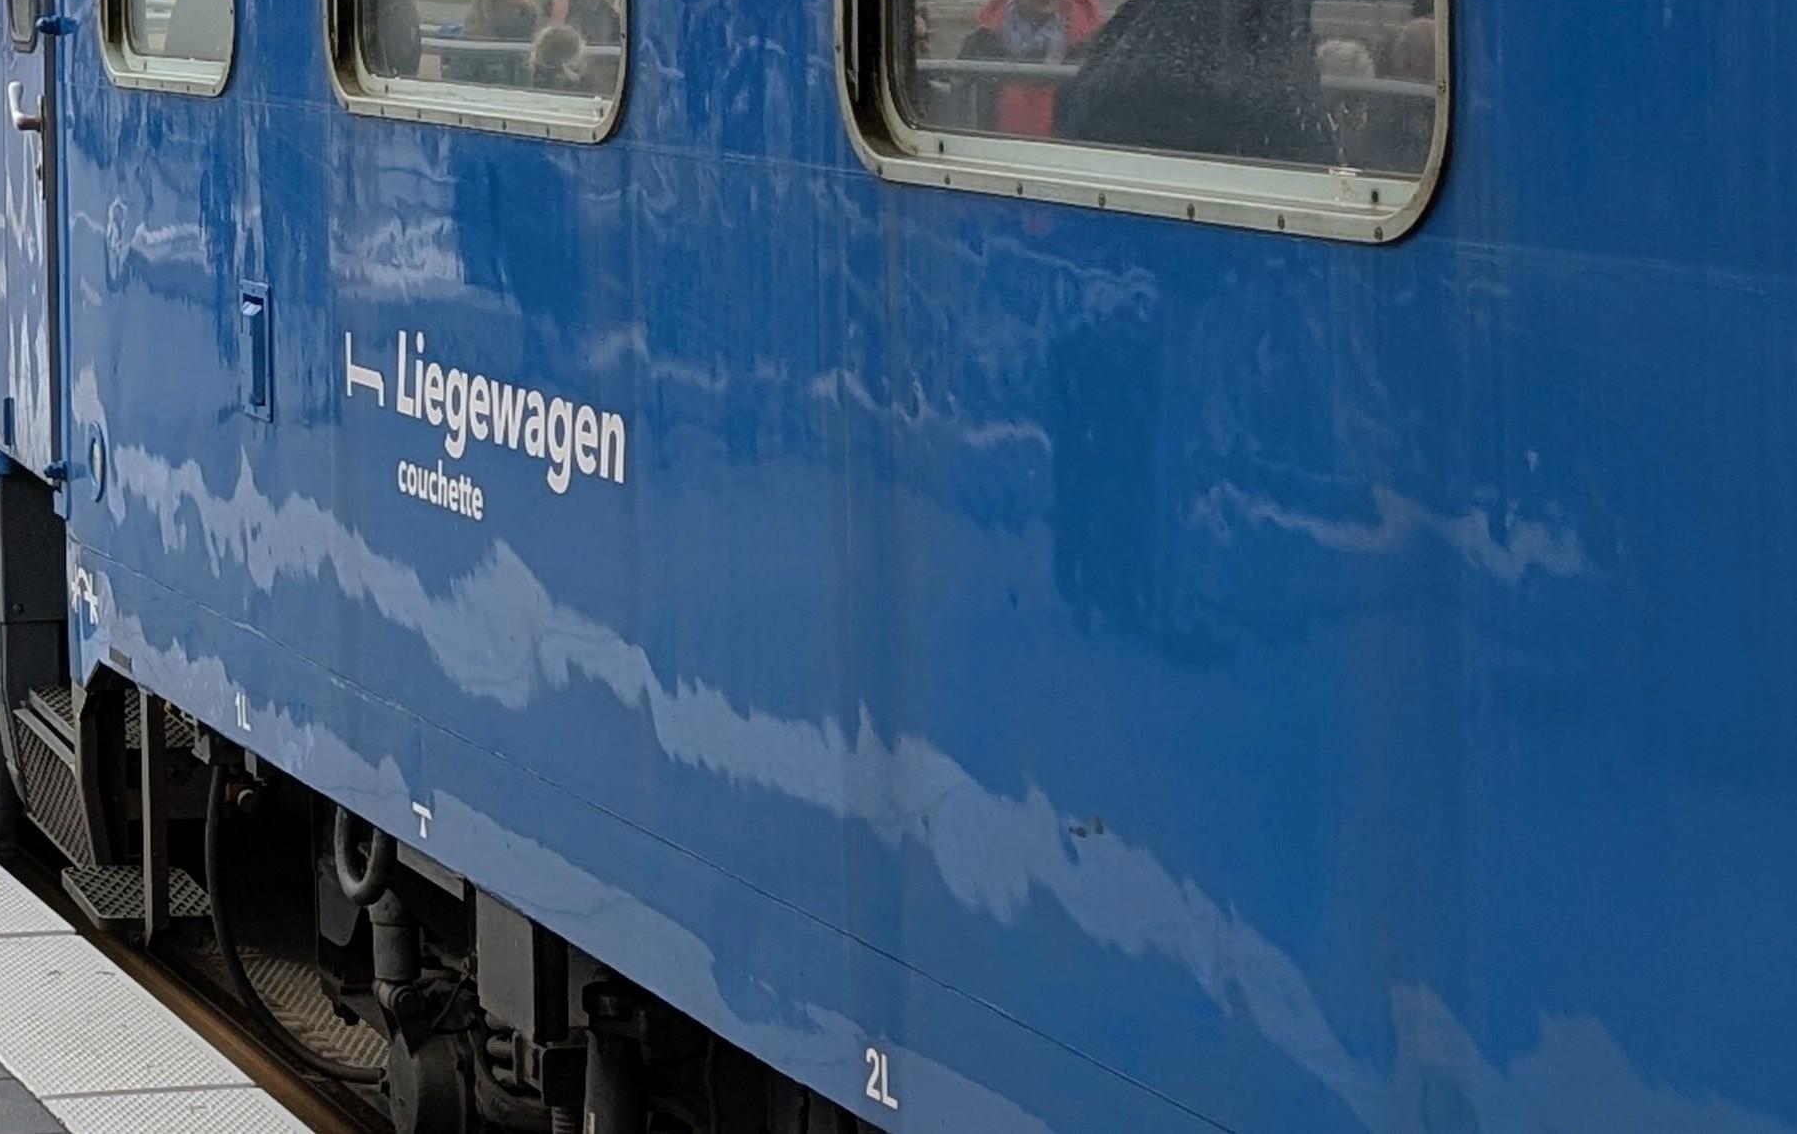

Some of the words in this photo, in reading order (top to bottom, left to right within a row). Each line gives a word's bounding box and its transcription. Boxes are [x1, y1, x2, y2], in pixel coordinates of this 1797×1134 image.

[396, 329, 626, 495] Liegewagen
[397, 459, 484, 521] couchette
[235, 691, 252, 733] 1L
[864, 1047, 899, 1110] 2L
